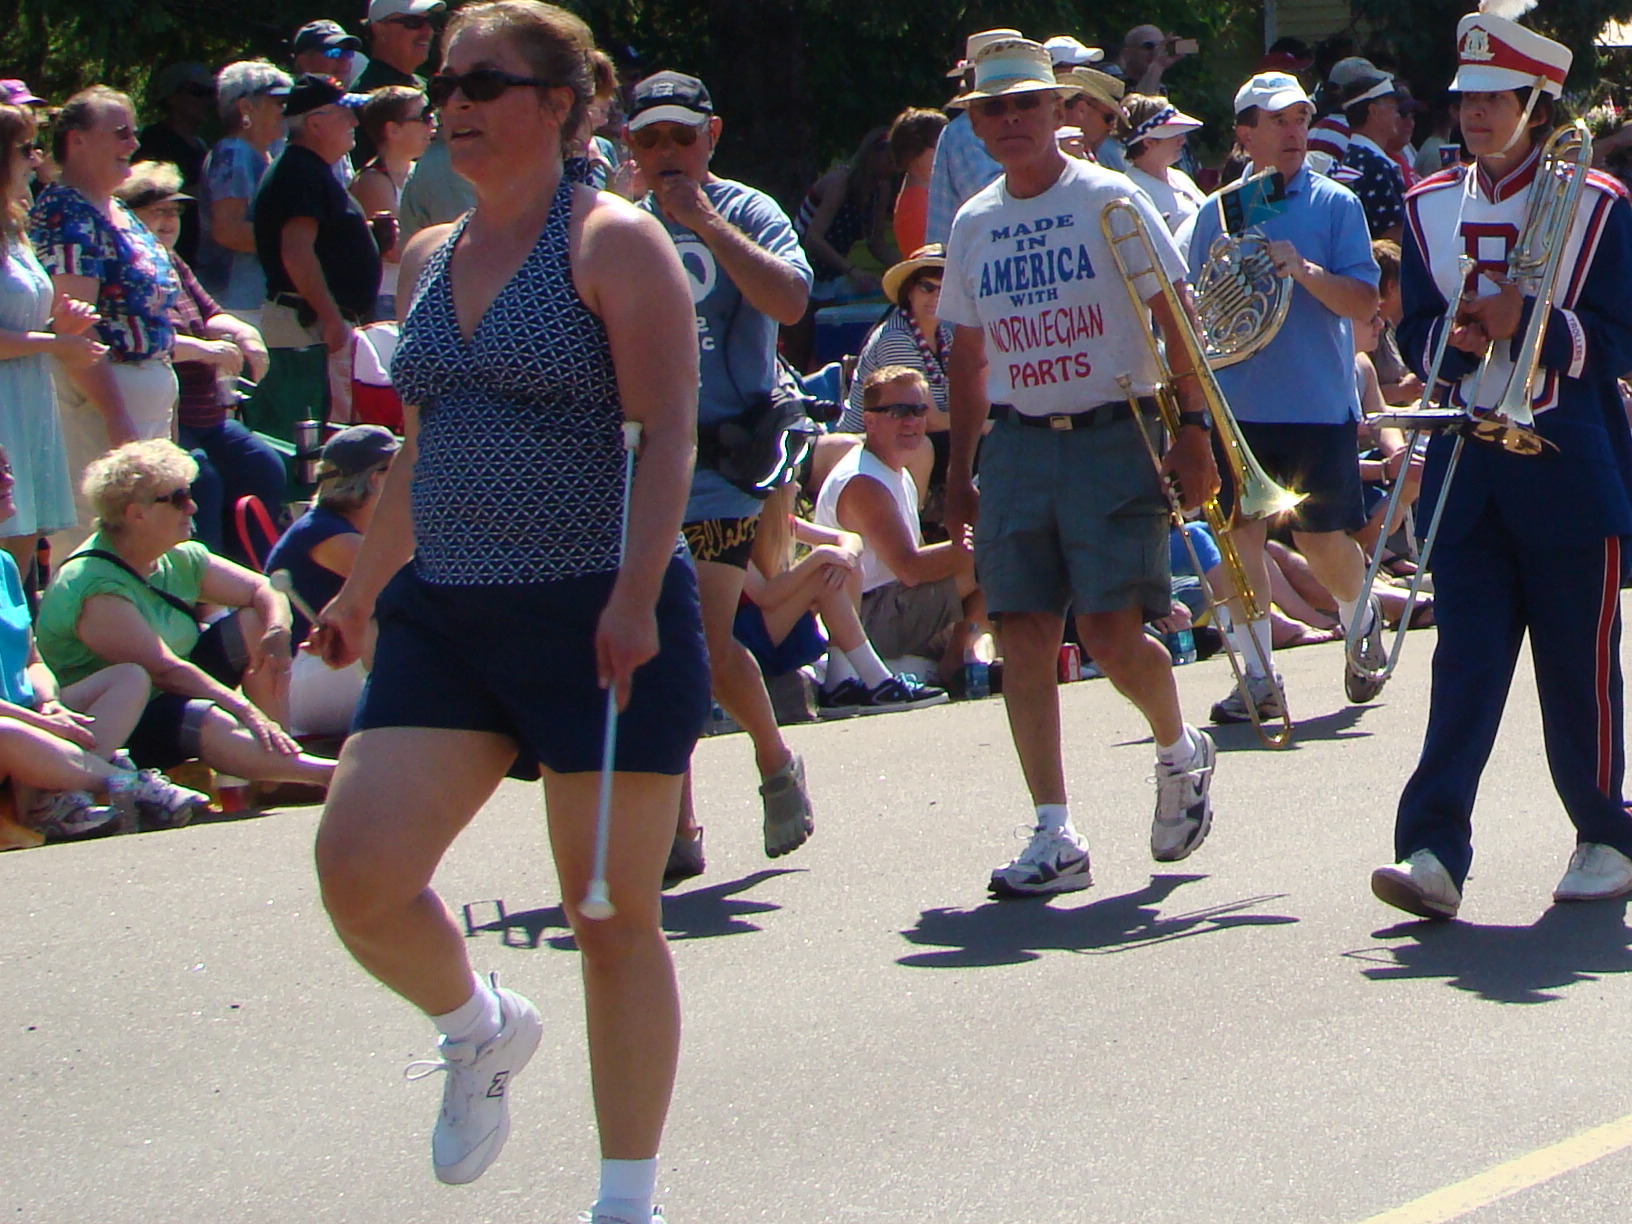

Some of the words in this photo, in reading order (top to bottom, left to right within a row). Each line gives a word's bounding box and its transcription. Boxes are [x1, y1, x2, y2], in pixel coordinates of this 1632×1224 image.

[991, 214, 1075, 242] MADE
[1016, 234, 1047, 253] IN
[979, 244, 1096, 298] AMERICA
[1009, 287, 1059, 308] WITH
[988, 303, 1104, 353] NORWEGIAN
[1567, 318, 1583, 362] TROLLERS
[1009, 352, 1092, 389] PARTS
